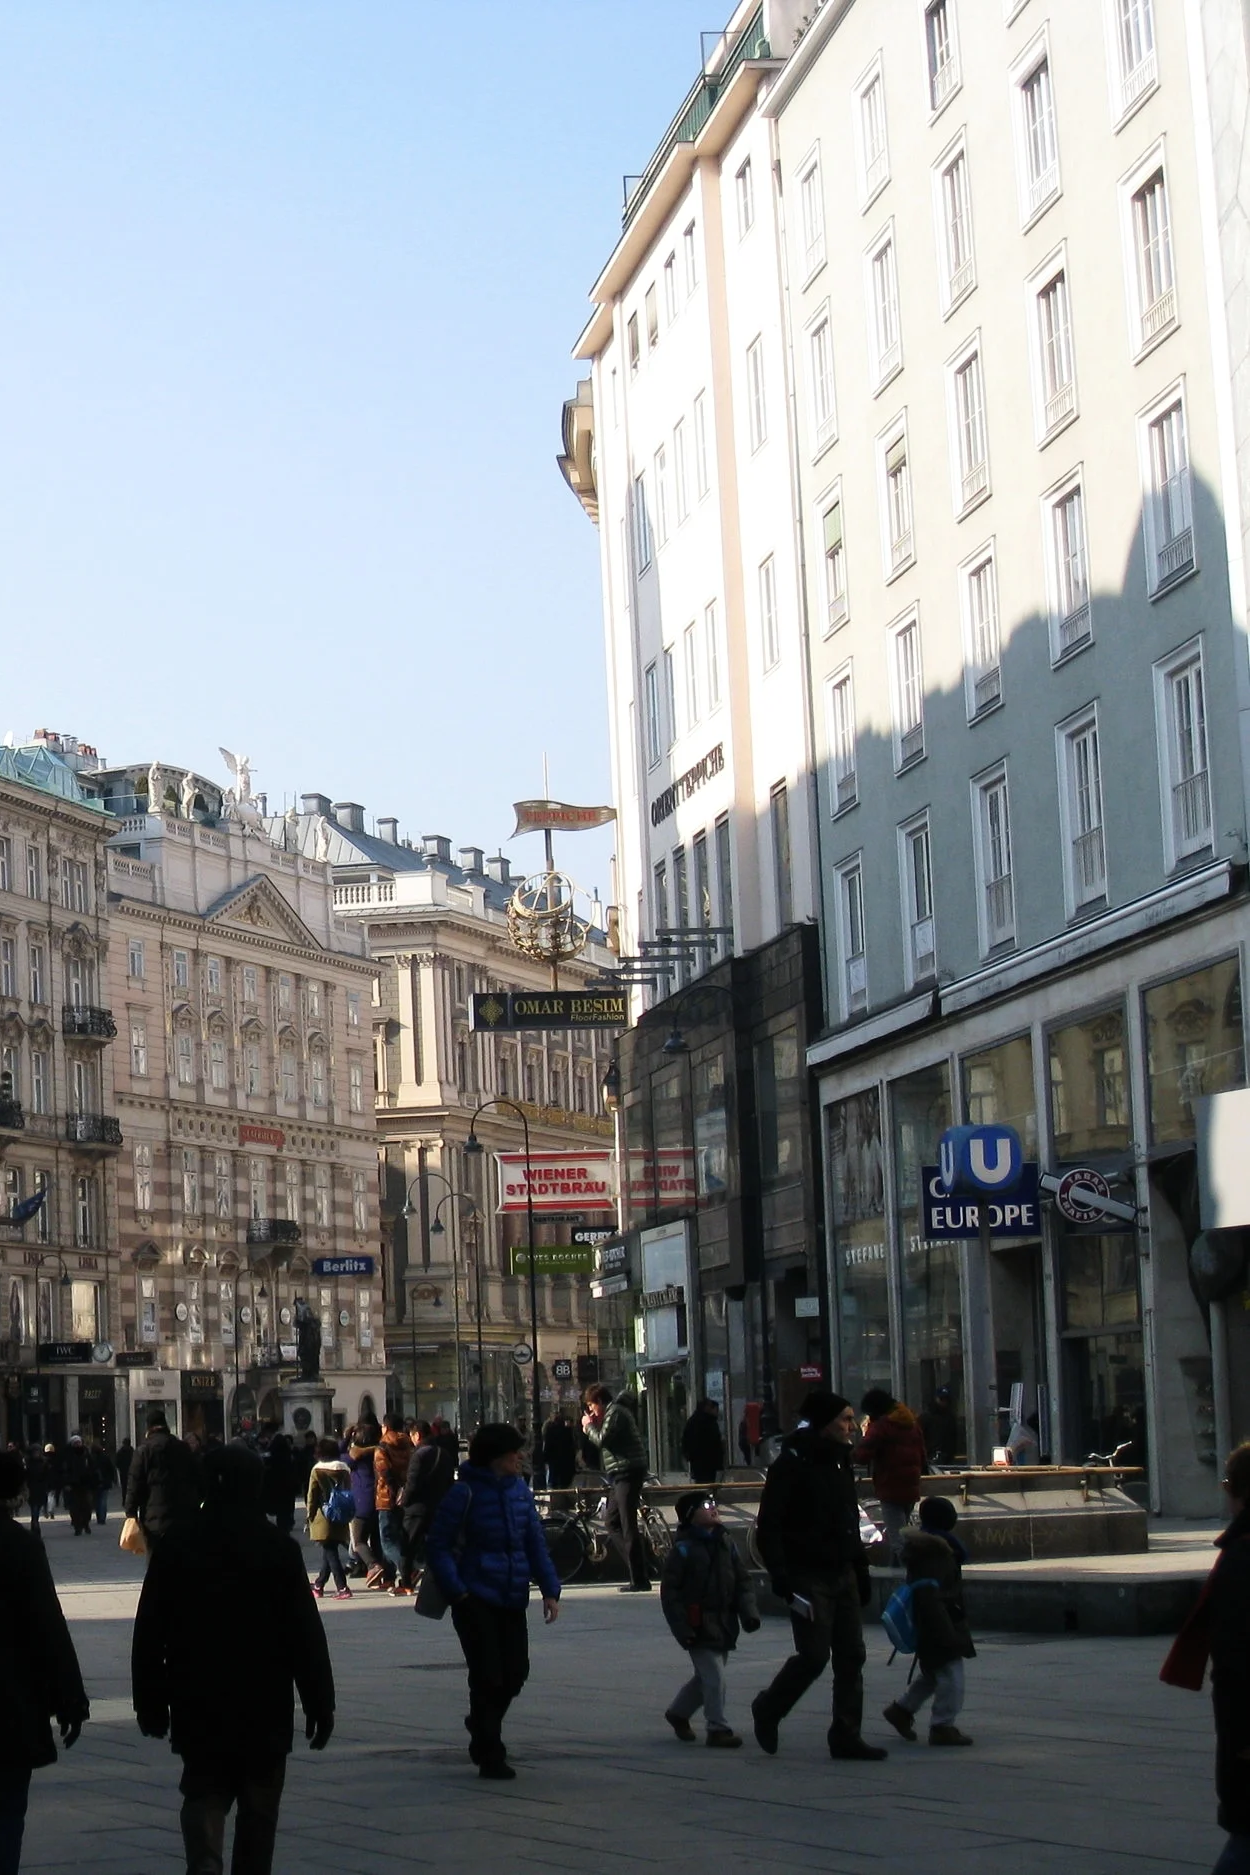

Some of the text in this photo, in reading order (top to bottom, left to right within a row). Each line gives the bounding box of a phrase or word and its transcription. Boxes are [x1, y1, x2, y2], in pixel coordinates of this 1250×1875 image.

[523, 809, 597, 822] TEPPICHE
[514, 998, 624, 1014] OMAR BESIM
[570, 1013, 625, 1022] FloorFashion
[940, 1141, 954, 1187] U
[969, 1138, 1012, 1184] U
[522, 1167, 588, 1182] WIENER
[1067, 1172, 1106, 1192] TABAK
[505, 1181, 606, 1197] STADTBRÄU
[1060, 1193, 1098, 1220] TRAFIK
[575, 1231, 612, 1242] GERRY
[322, 1260, 367, 1273] Berlitz
[55, 1346, 75, 1356] IWC
